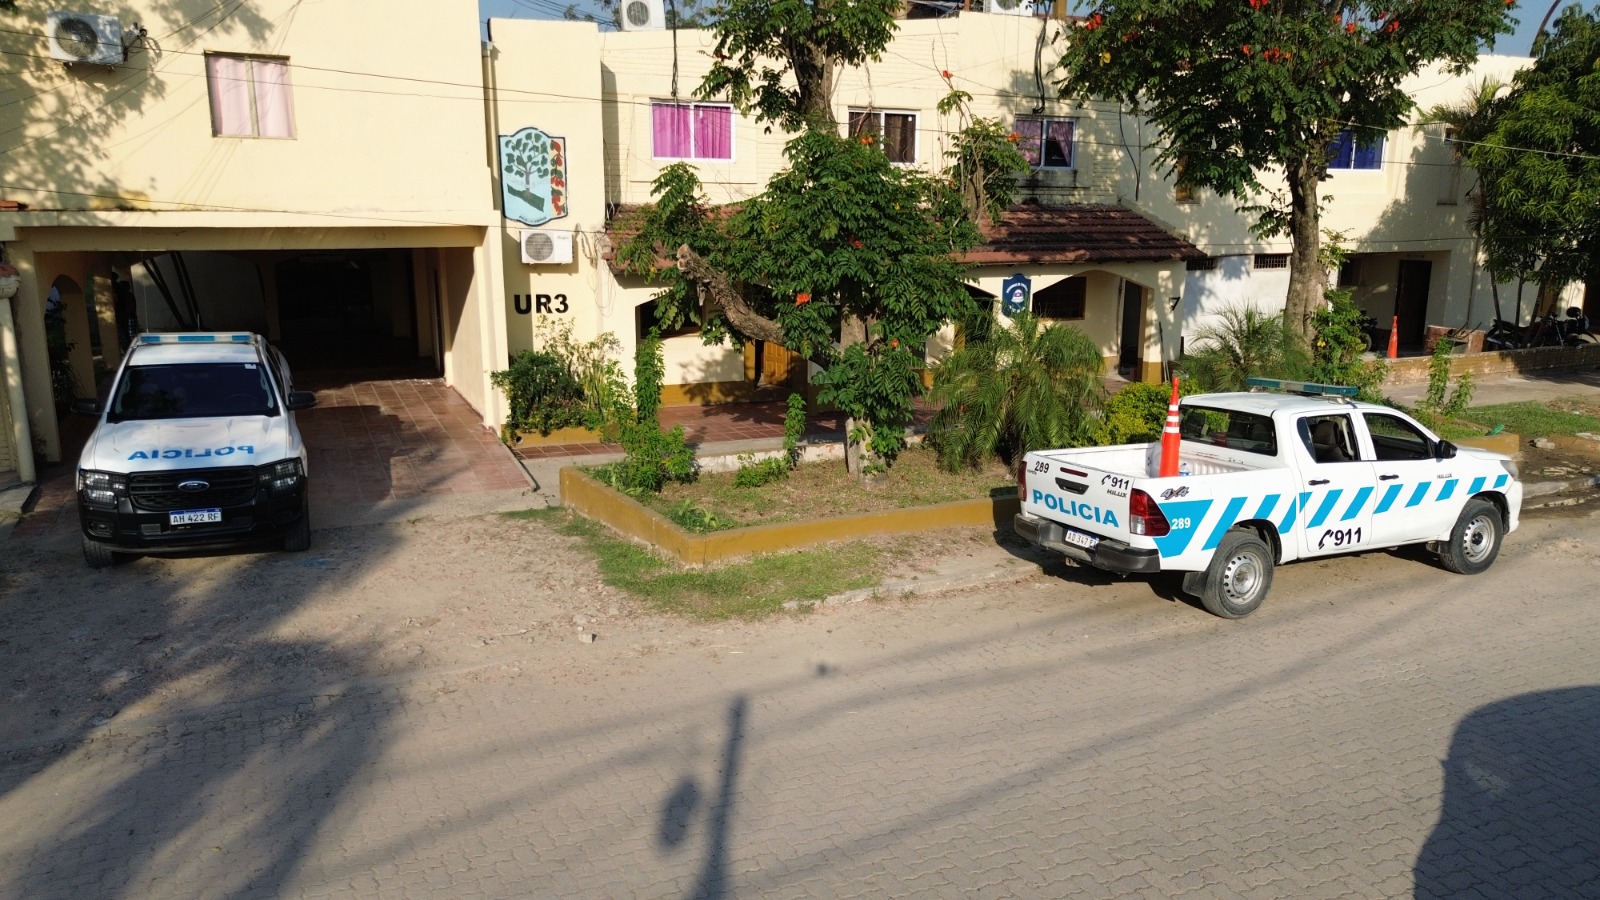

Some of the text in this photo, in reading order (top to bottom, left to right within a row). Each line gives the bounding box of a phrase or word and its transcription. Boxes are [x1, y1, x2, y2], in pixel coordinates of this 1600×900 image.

[514, 293, 569, 315] UR3
[1034, 460, 1050, 474] 289
[1110, 476, 1130, 491] 911
[1106, 489, 1127, 498] HILUX
[1032, 489, 1119, 528] POLICIA
[188, 513, 205, 522] 422
[1171, 517, 1191, 530] 289
[1334, 526, 1362, 546] 911
